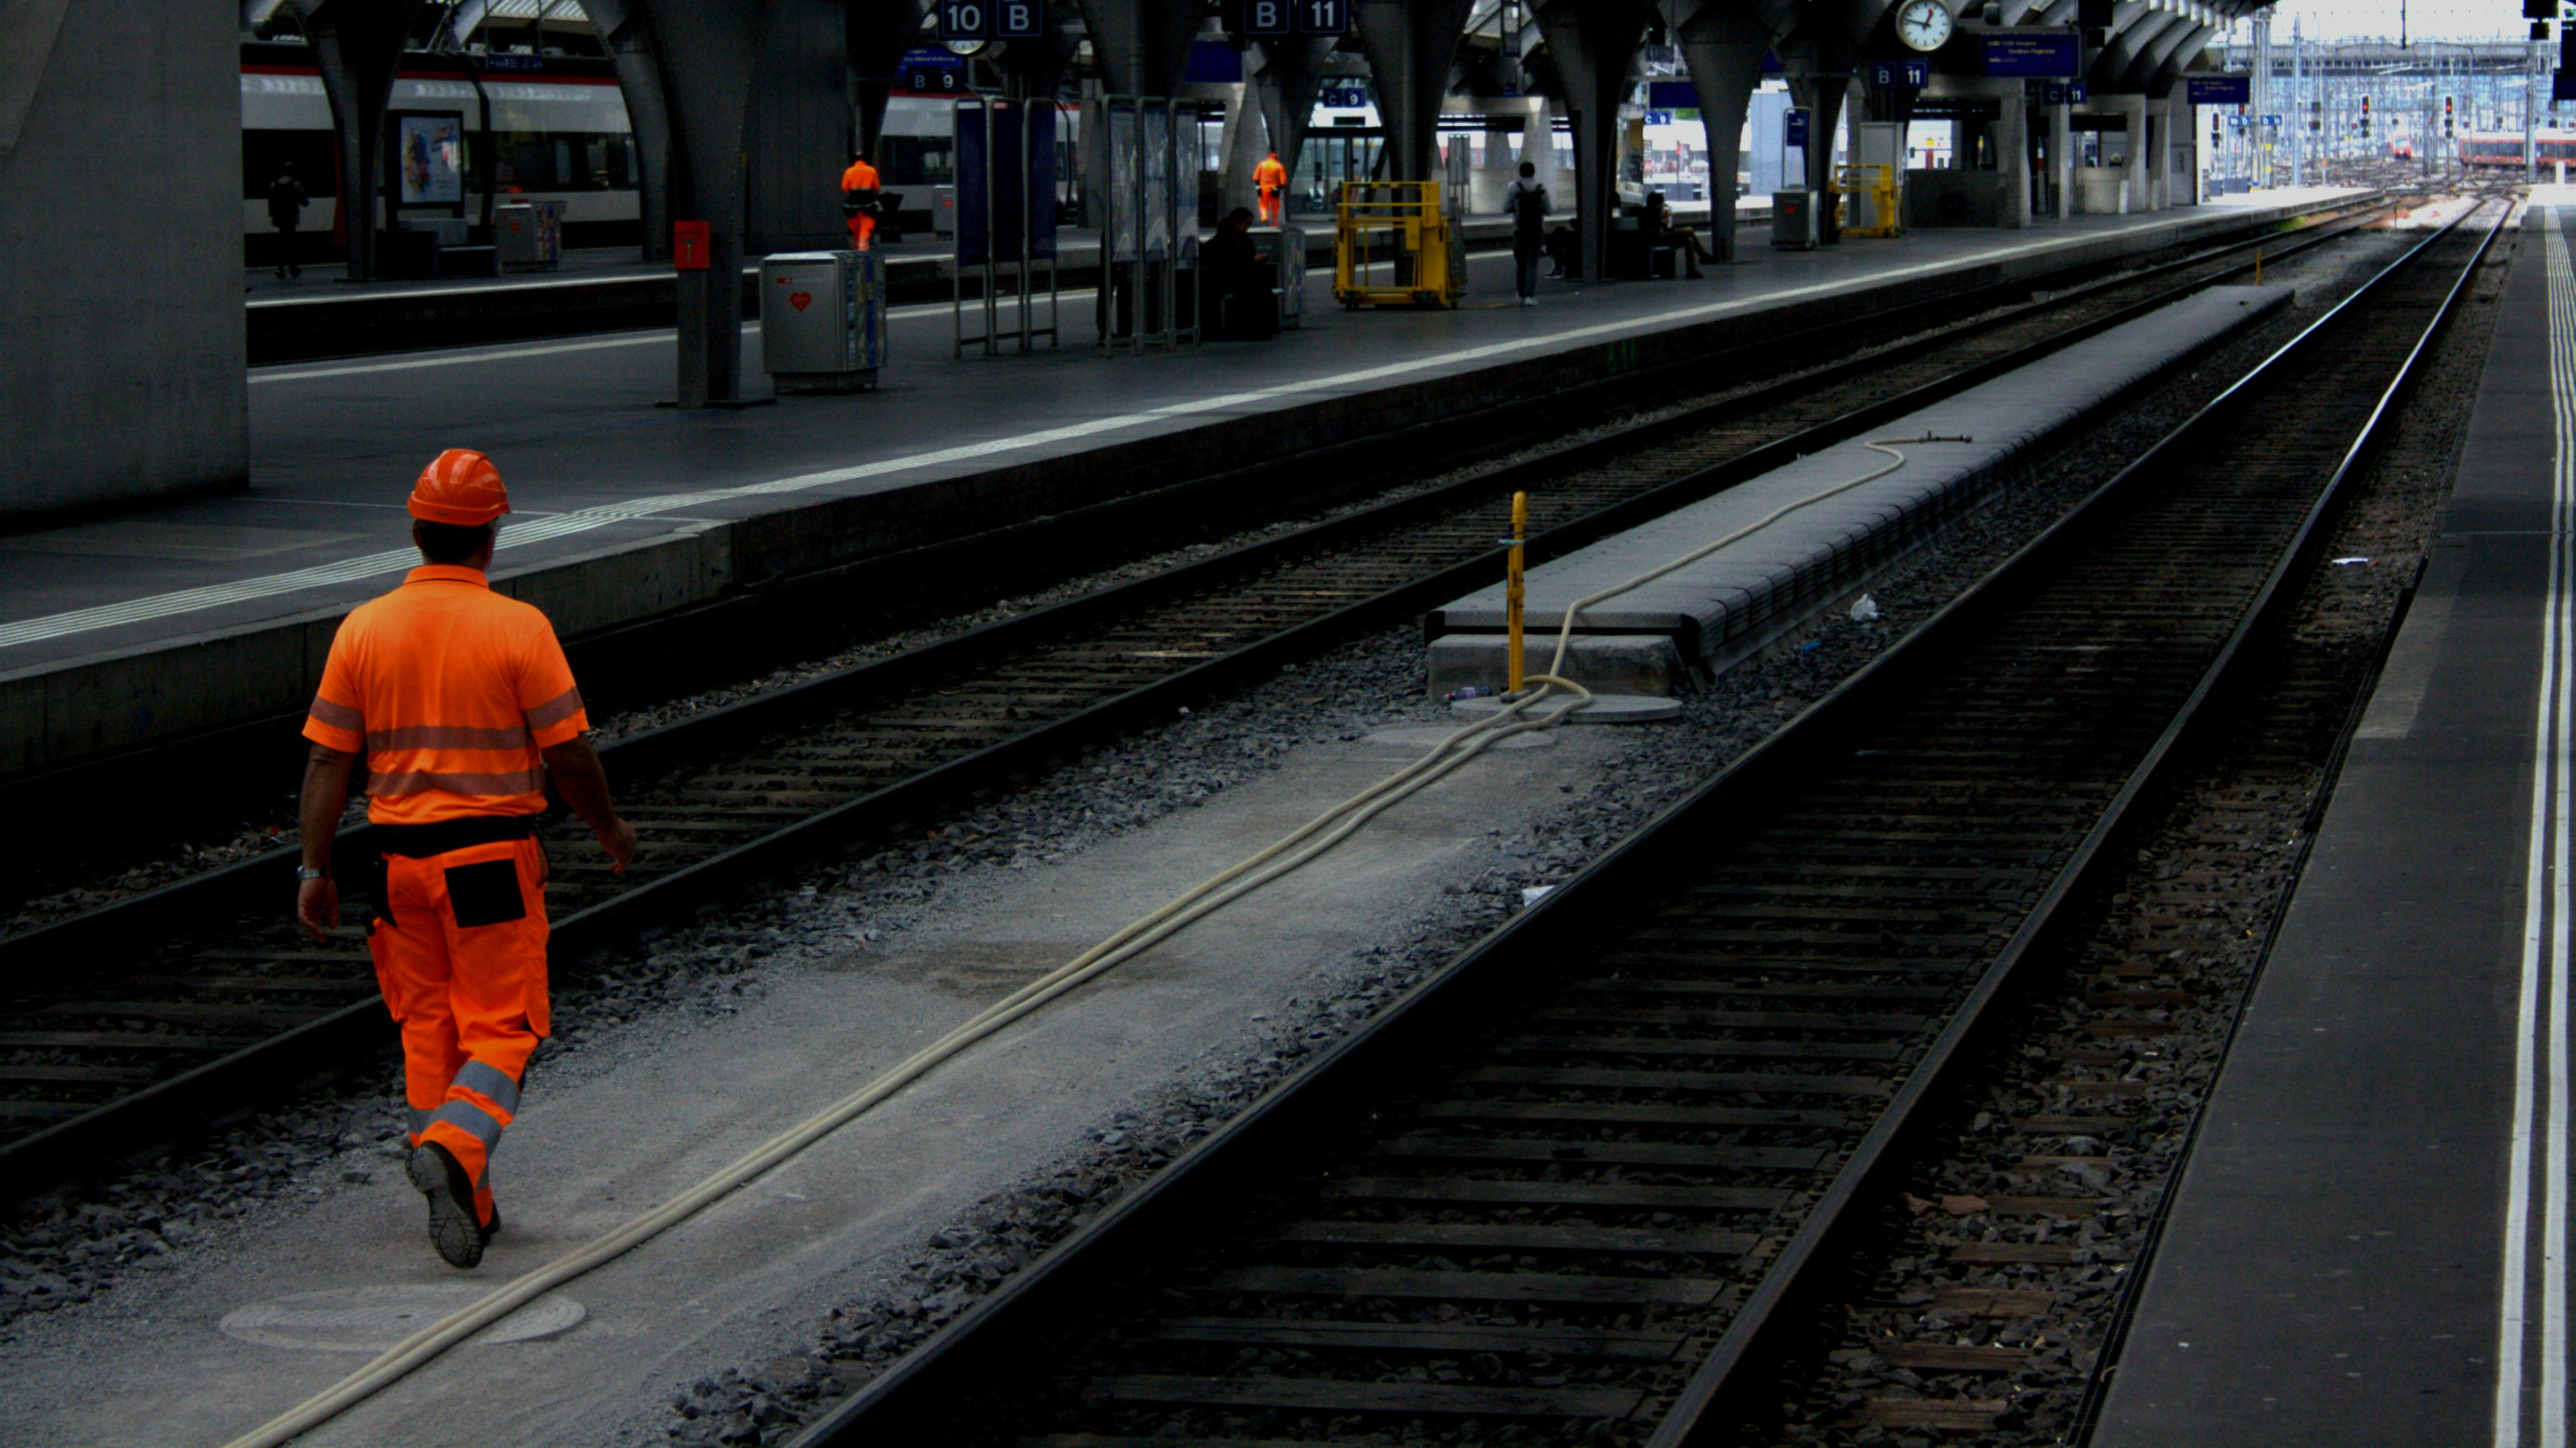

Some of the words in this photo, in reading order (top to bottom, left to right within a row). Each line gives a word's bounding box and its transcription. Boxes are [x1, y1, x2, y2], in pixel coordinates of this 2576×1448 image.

[947, 4, 981, 31] 10
[1009, 4, 1030, 31] B
[1257, 1, 1278, 28] B
[1311, 1, 1335, 28] 11
[914, 74, 925, 88] B
[942, 74, 954, 89] 9
[1878, 69, 1890, 84] B
[1906, 69, 1921, 84] 11
[1328, 94, 1337, 106] C
[1350, 94, 1359, 105] 9
[2049, 90, 2059, 102] C
[2071, 89, 2081, 102] 11
